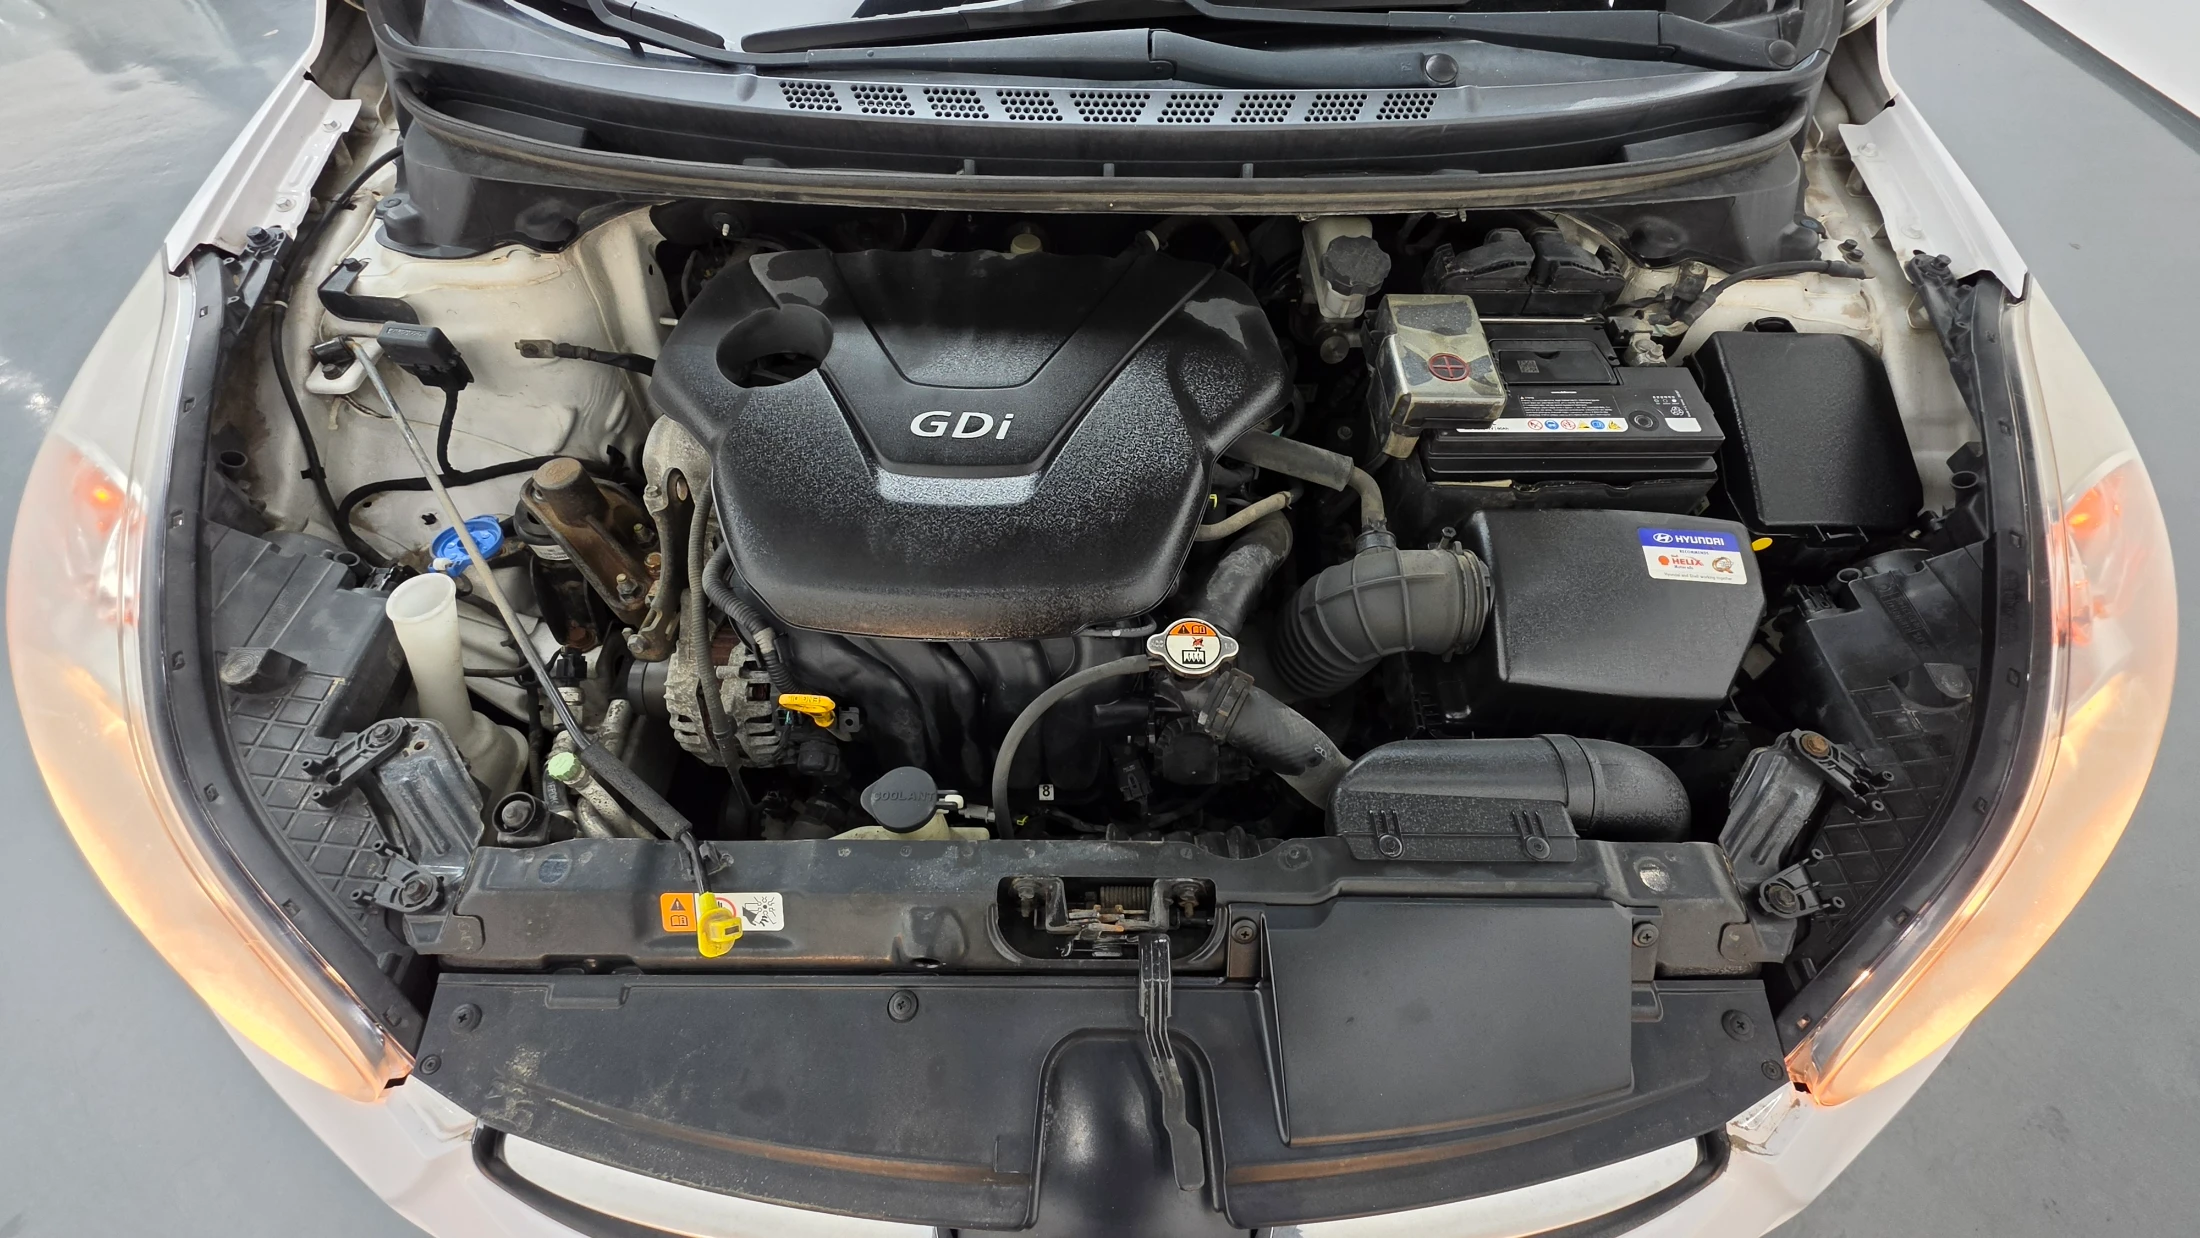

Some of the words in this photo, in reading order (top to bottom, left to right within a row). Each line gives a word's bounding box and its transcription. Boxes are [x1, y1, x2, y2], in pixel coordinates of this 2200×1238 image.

[910, 410, 1015, 440] GDi
[1675, 535, 1725, 546] HYUNDAI
[1672, 558, 1704, 566] HELIX
[1700, 573, 1716, 581] working
[873, 790, 936, 801] COOLANT
[1042, 784, 1051, 797] 8
